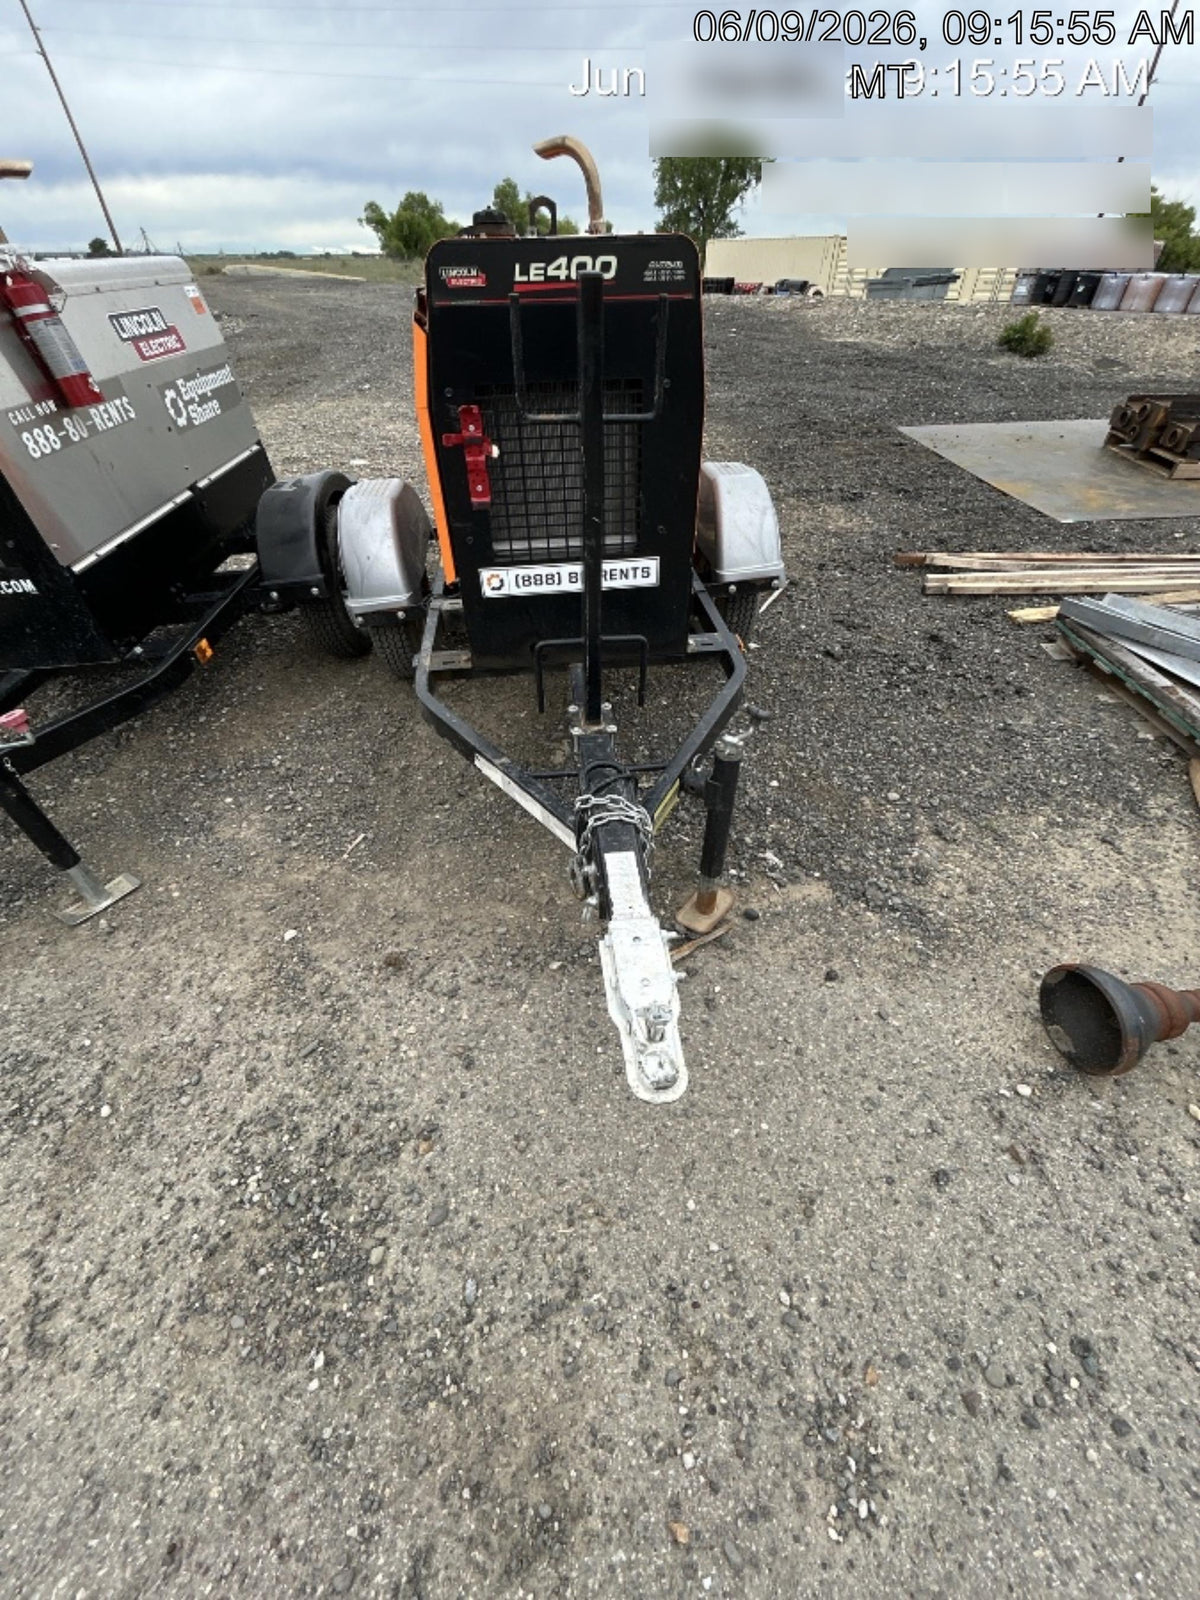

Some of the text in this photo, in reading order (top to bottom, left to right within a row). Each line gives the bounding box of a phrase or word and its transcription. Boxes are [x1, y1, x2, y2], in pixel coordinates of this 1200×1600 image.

[513, 255, 618, 282] LE400
[112, 310, 168, 339] LINCOLN
[138, 334, 181, 357] ELECTRIC
[176, 363, 235, 402] Equipment
[8, 399, 57, 426] CALL NOW
[188, 399, 221, 425] Share
[22, 396, 136, 459] 888-80-RENTS
[515, 572, 561, 588] (888)
